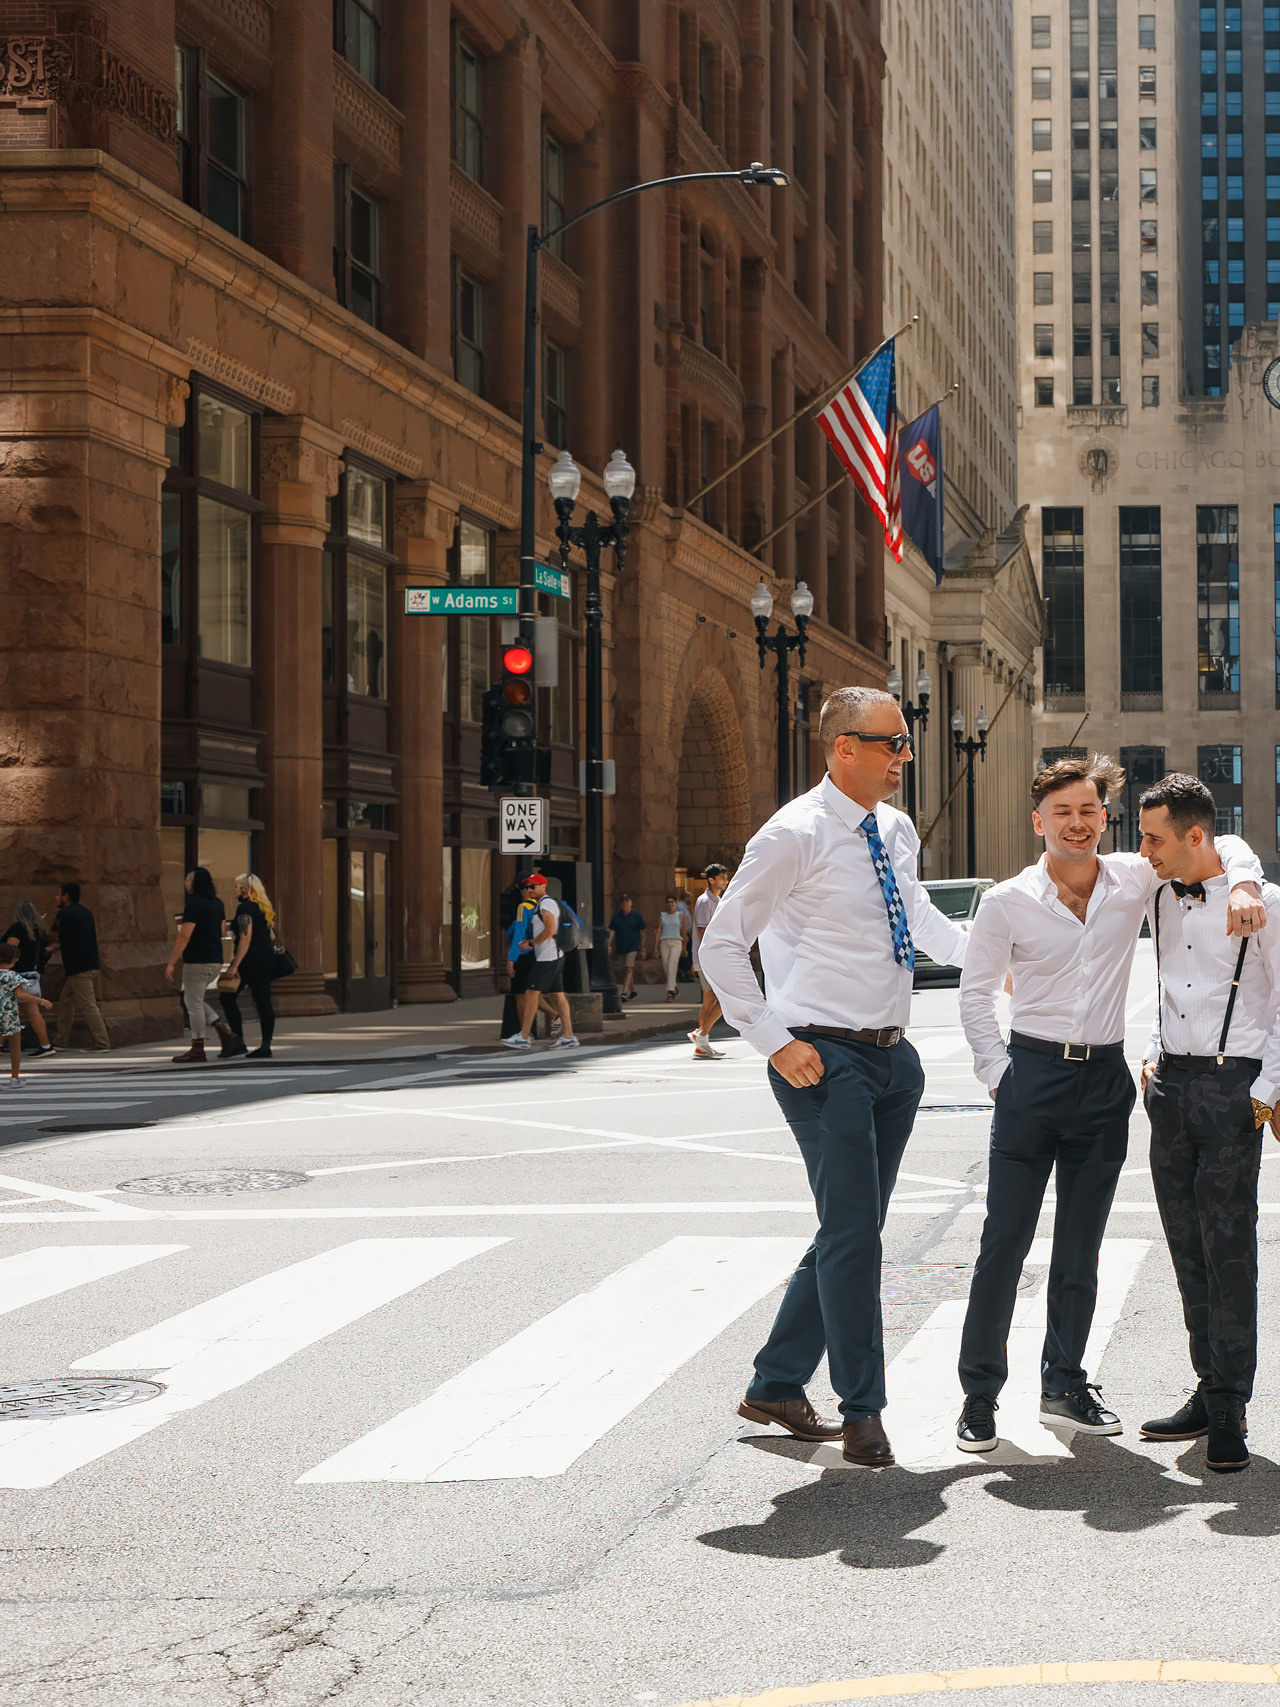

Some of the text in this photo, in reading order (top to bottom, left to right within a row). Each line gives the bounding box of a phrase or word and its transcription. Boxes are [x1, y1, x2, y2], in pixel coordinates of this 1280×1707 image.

[1135, 449, 1245, 470] CHICAGO
[543, 571, 557, 589] Salle
[432, 593, 513, 609] W Adams St
[506, 803, 537, 817] ONE
[505, 818, 538, 832] WAY
